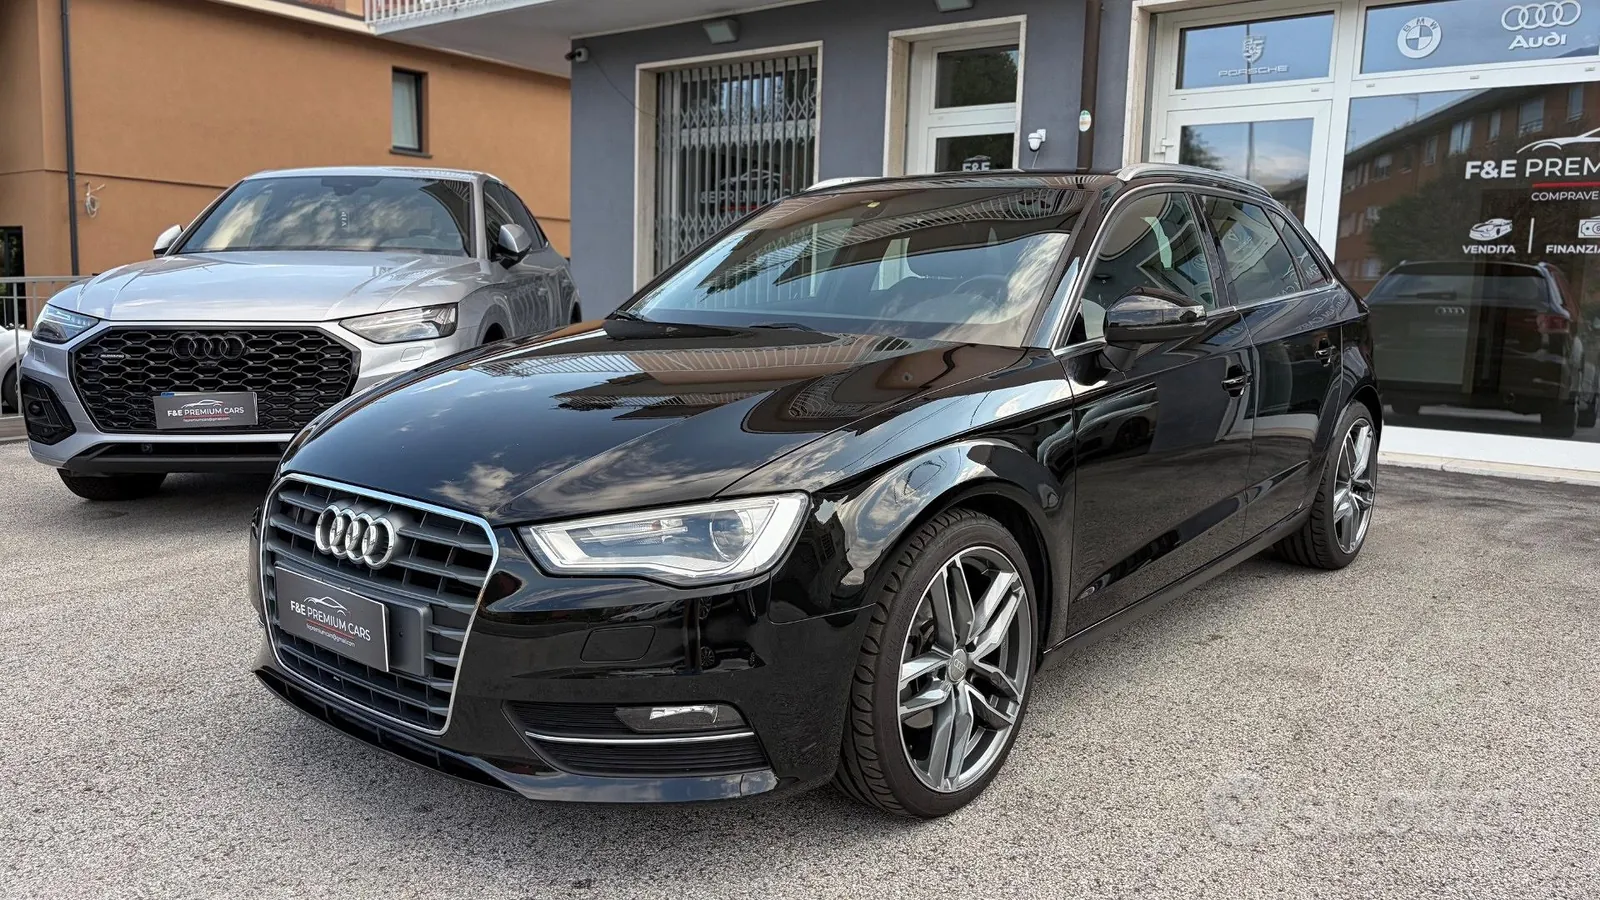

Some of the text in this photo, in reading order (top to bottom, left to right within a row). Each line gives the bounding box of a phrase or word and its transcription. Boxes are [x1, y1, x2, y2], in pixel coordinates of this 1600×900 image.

[1508, 33, 1567, 50] Audi
[1218, 65, 1288, 77] PORSCHE
[962, 162, 990, 172] F&E
[1465, 160, 1517, 179] F&E
[1462, 245, 1516, 254] VENDITA
[184, 408, 221, 416] PREMIUM
[290, 600, 371, 641] F&E PREMIUM CARS
